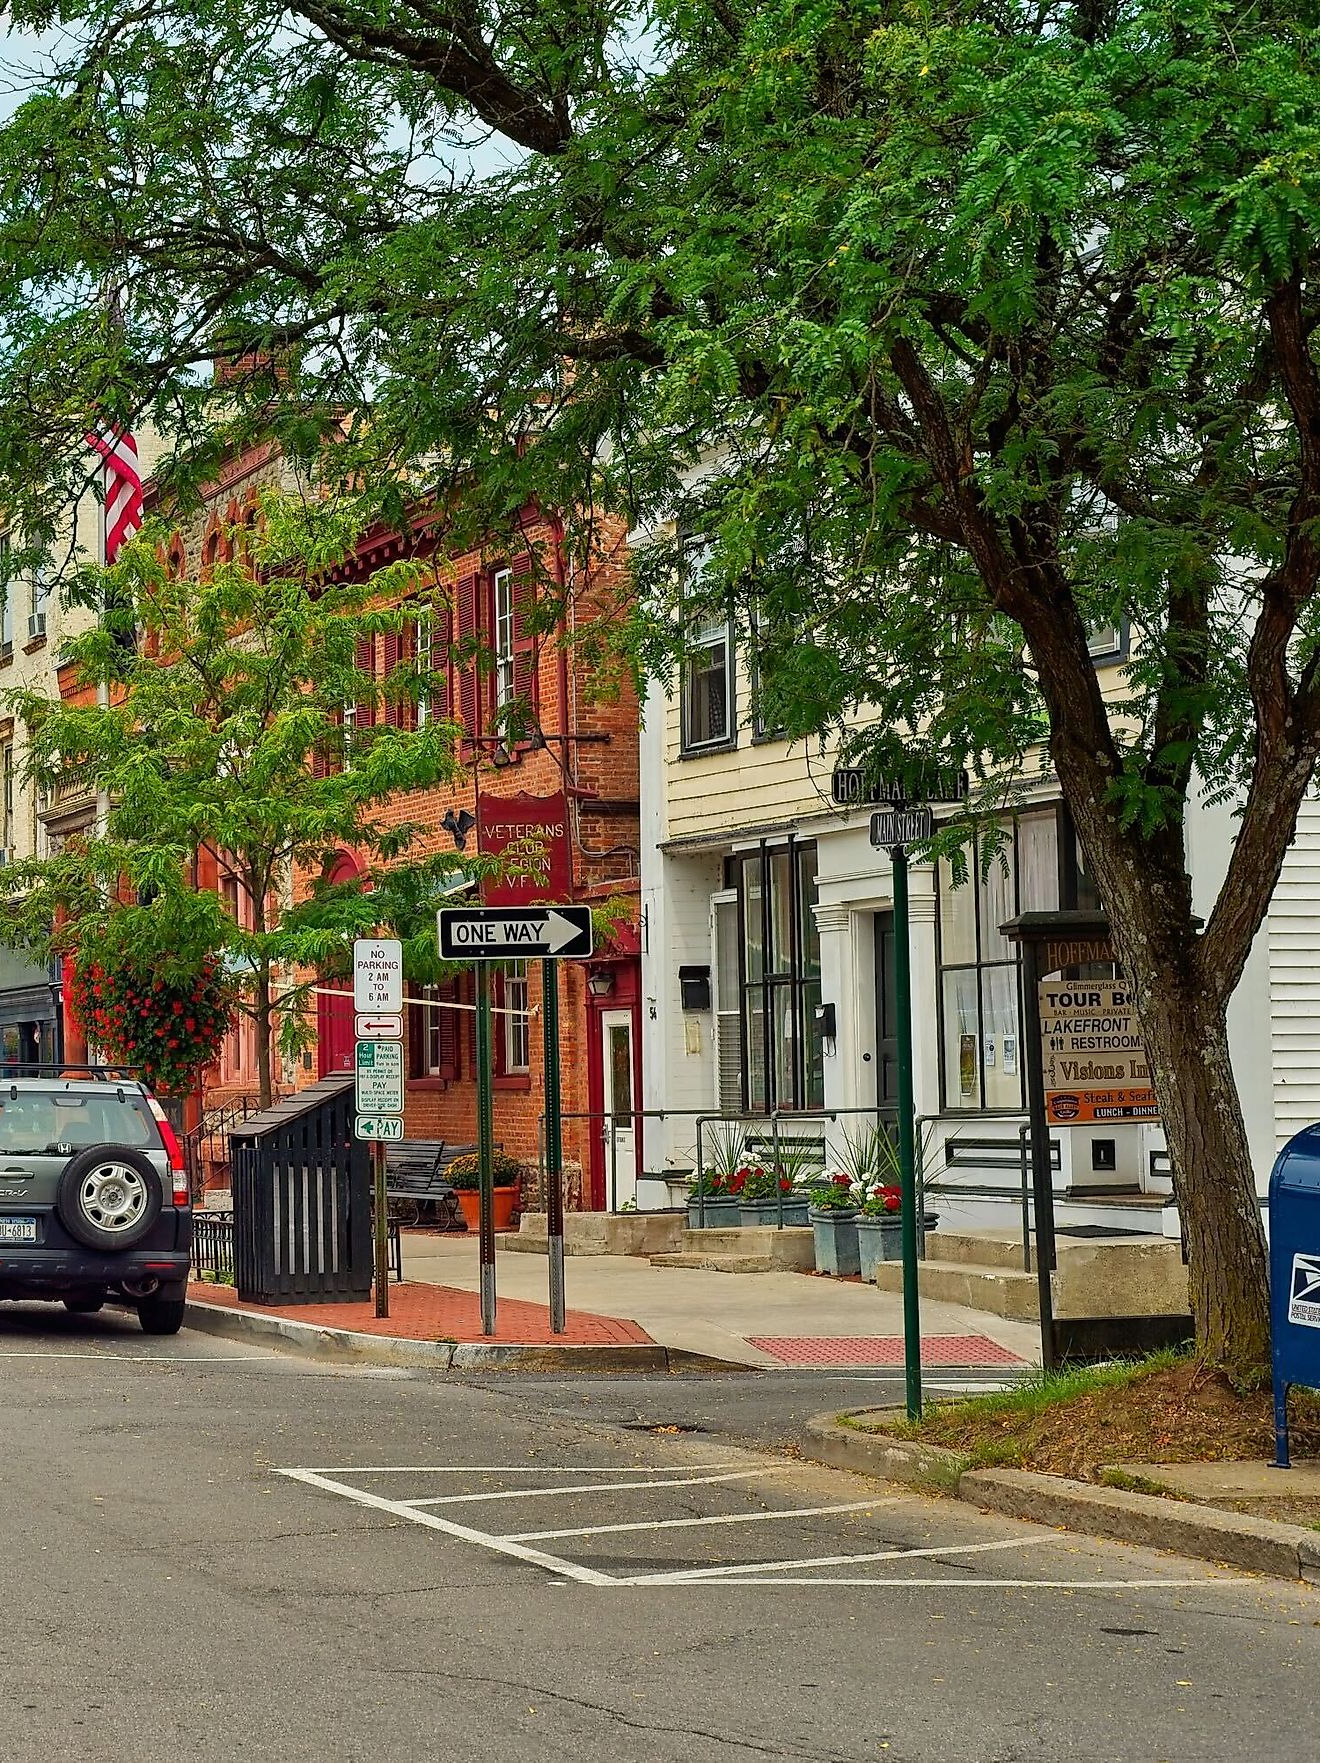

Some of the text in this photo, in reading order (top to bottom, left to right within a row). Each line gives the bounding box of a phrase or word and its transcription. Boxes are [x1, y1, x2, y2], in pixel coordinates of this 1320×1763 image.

[484, 823, 564, 839] VETERANS
[876, 812, 925, 843] MAIN STREET
[509, 857, 552, 872] EGION
[456, 922, 545, 943] ONE WAY
[370, 950, 386, 959] NO
[357, 960, 399, 970] PARKING
[368, 972, 389, 982] 2 AM
[373, 983, 385, 991] TO
[1065, 981, 1117, 992] Glimmerglass
[368, 992, 389, 1002] 6 AM
[1046, 992, 1102, 1008] TOUR
[1053, 1009, 1068, 1017] BAR
[1073, 1008, 1096, 1016] MUSIC
[1043, 1017, 1131, 1035] LAKEFRONT
[362, 1043, 369, 1051] 2
[1060, 1060, 1125, 1081] Visions
[372, 1081, 387, 1089] PAY
[1083, 1091, 1114, 1104] Steak
[1117, 1091, 1126, 1103] &
[1096, 1106, 1124, 1118] LUNCH
[377, 1121, 399, 1136] PAY
[1291, 1303, 1308, 1313] UNITED
